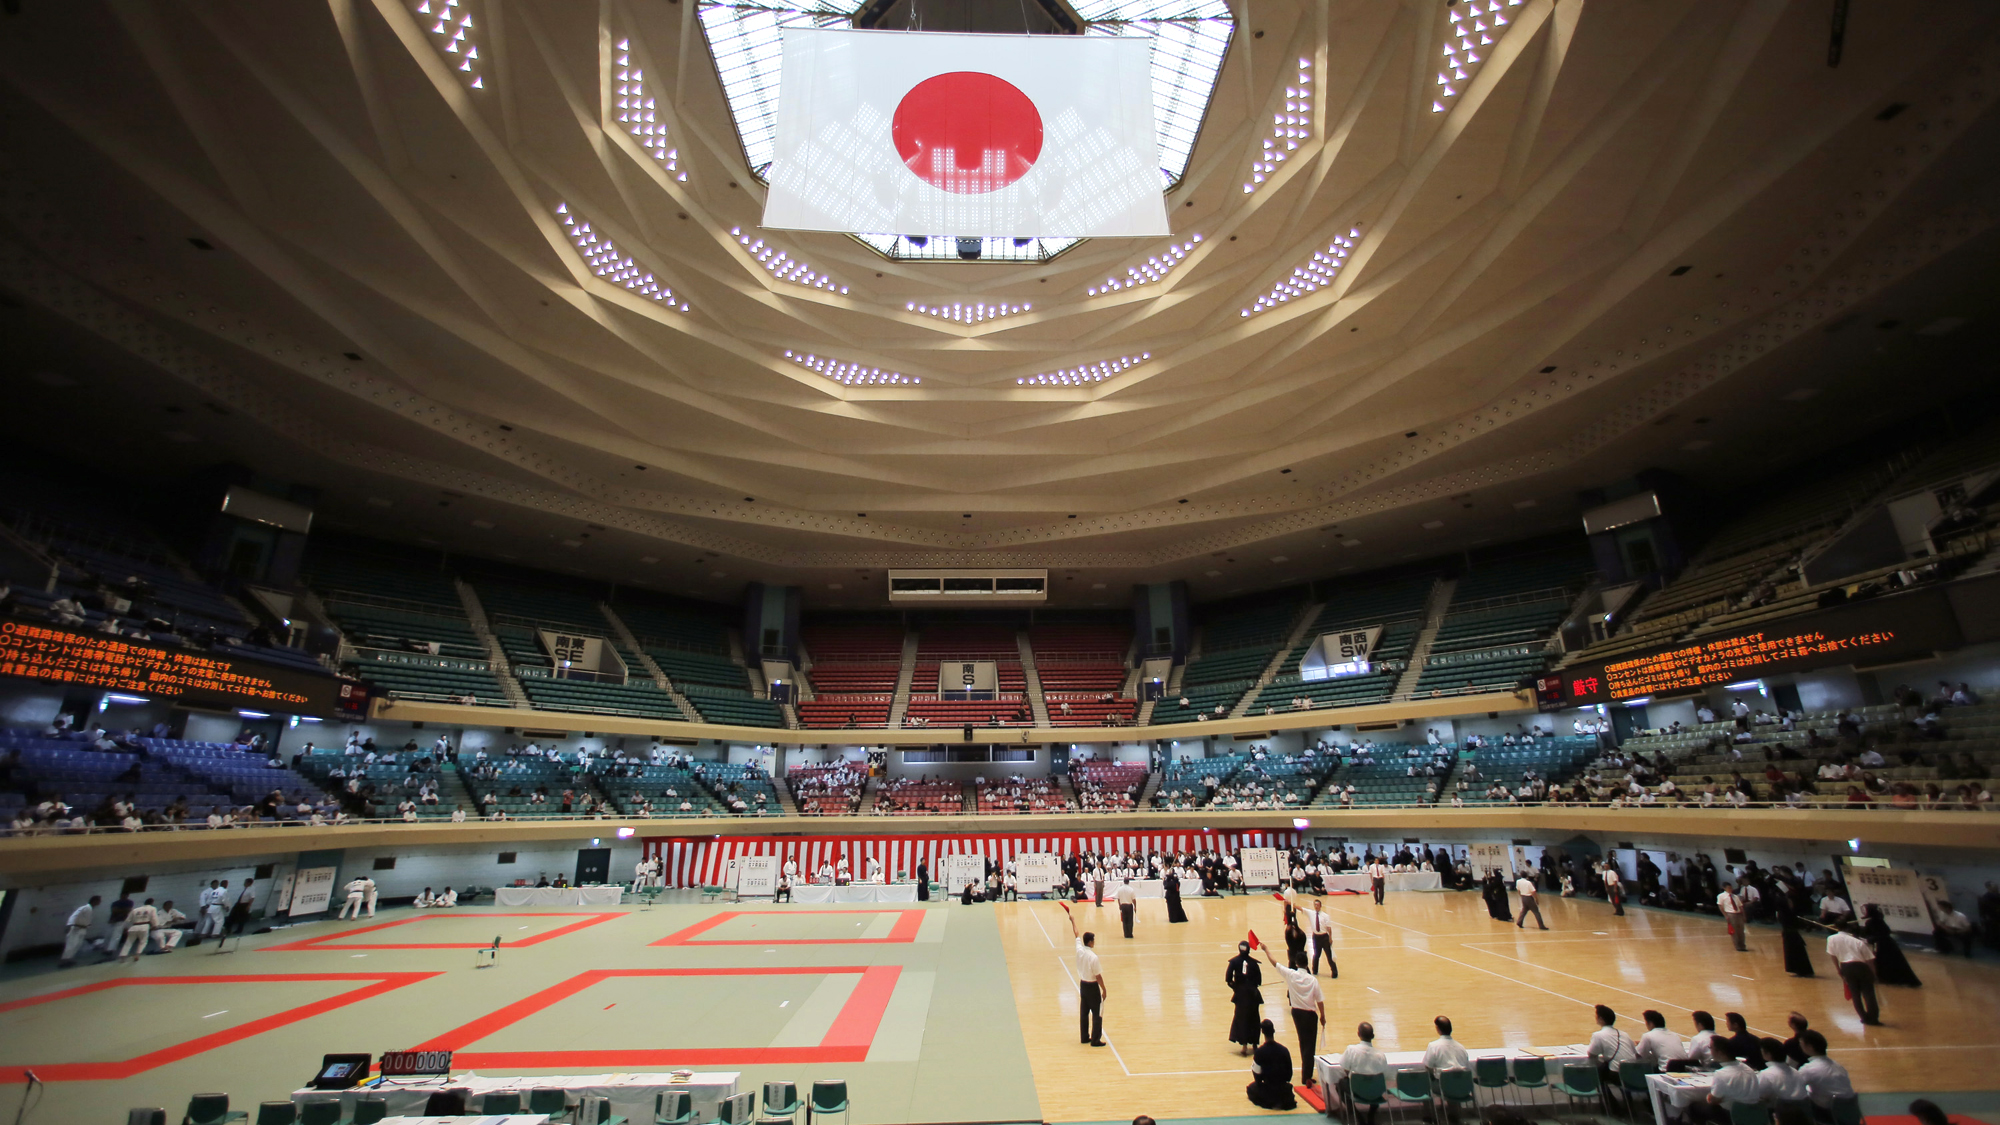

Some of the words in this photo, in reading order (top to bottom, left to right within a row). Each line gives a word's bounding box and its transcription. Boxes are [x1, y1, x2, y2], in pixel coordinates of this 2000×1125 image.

[555, 636, 586, 650] 南東
[1339, 632, 1367, 646] 南西
[555, 648, 583, 663] SE
[1341, 643, 1367, 658] SW
[963, 663, 974, 674] 南
[963, 675, 975, 685] S
[1572, 677, 1599, 697] 厳守
[1053, 857, 1058, 866] 1
[1279, 851, 1286, 860] 2
[730, 860, 736, 869] 2
[940, 859, 945, 867] 1
[1926, 878, 1938, 891] 3
